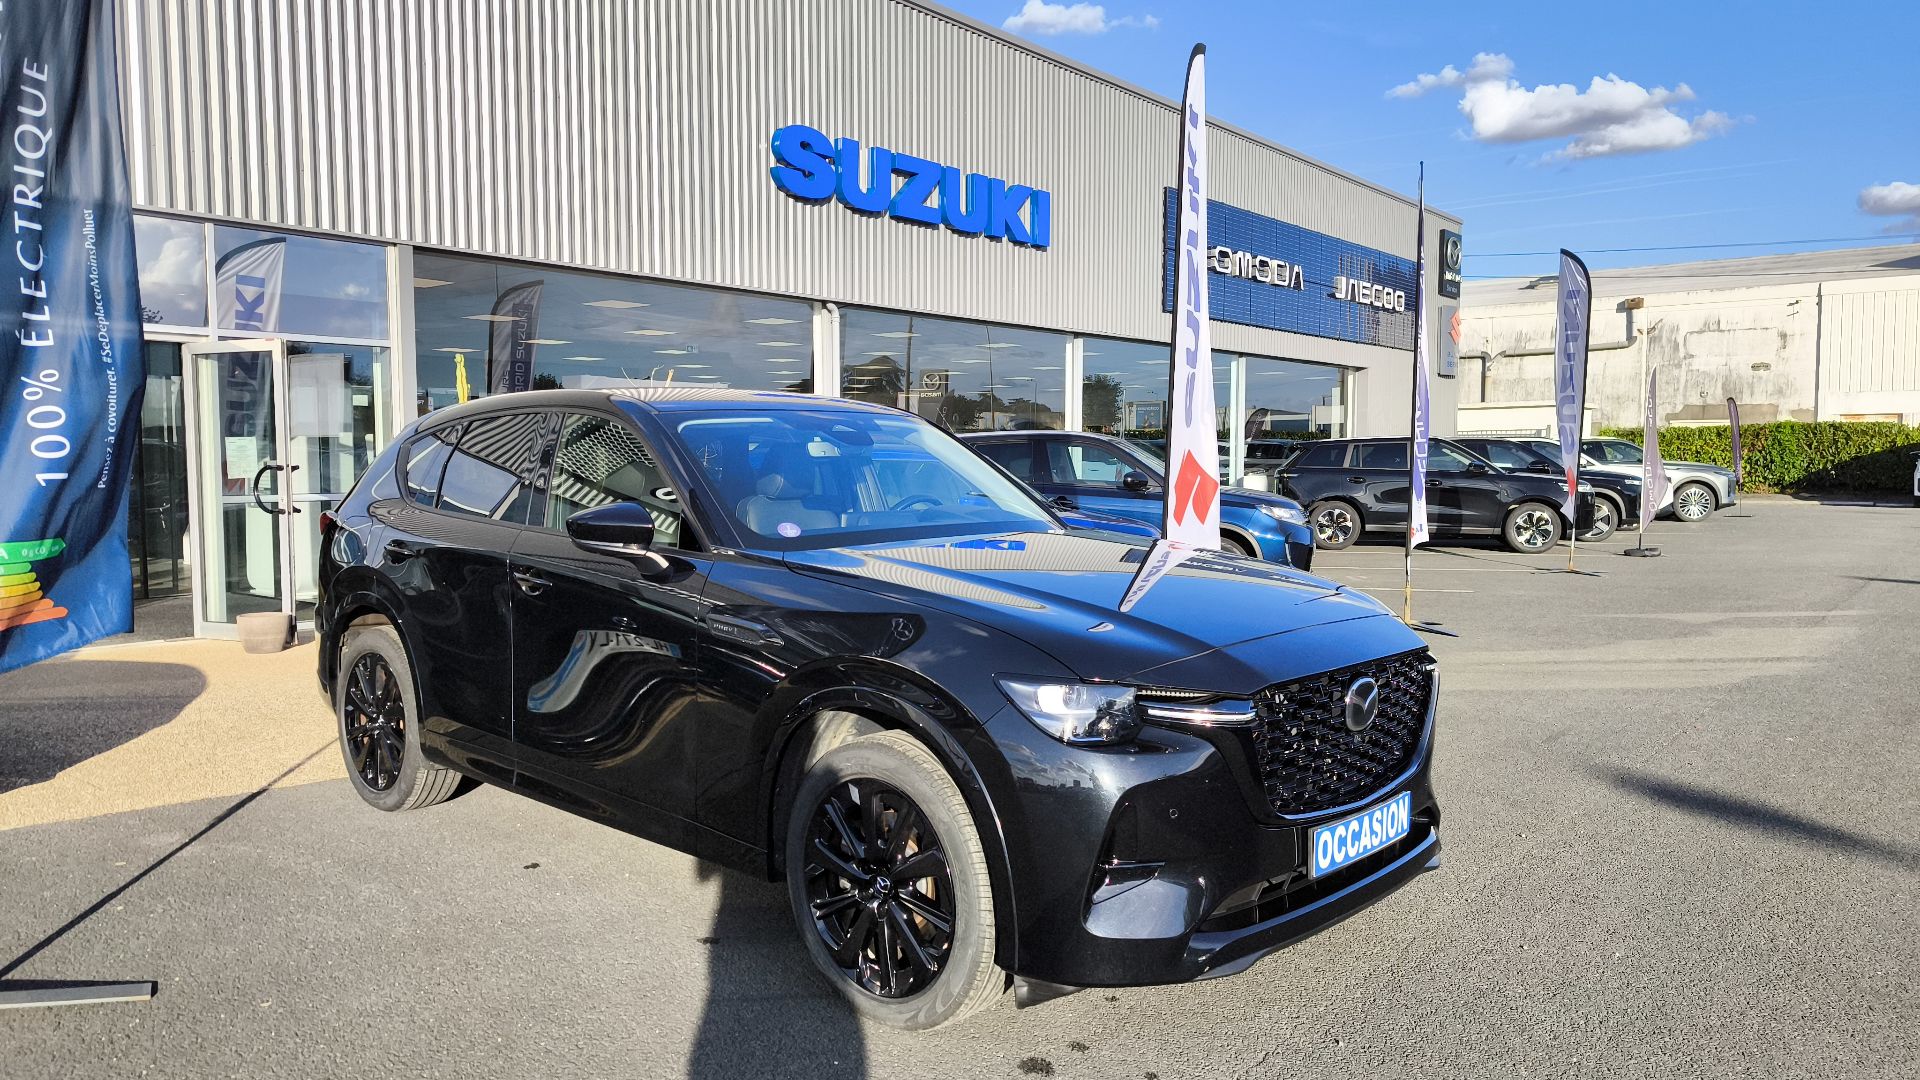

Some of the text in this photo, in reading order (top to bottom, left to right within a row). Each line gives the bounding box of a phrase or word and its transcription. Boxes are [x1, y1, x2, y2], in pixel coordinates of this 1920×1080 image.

[770, 124, 1051, 248] SUZUKI
[14, 57, 70, 487] 100% ÉLECTRIQUE
[1212, 245, 1406, 313] OMODA JAECOO
[223, 274, 267, 438] SUZKI
[516, 309, 529, 360] SUZUKI
[97, 447, 114, 489] Pensez
[106, 366, 118, 433] covoiturer.
[1317, 795, 1409, 869] OCCASION
